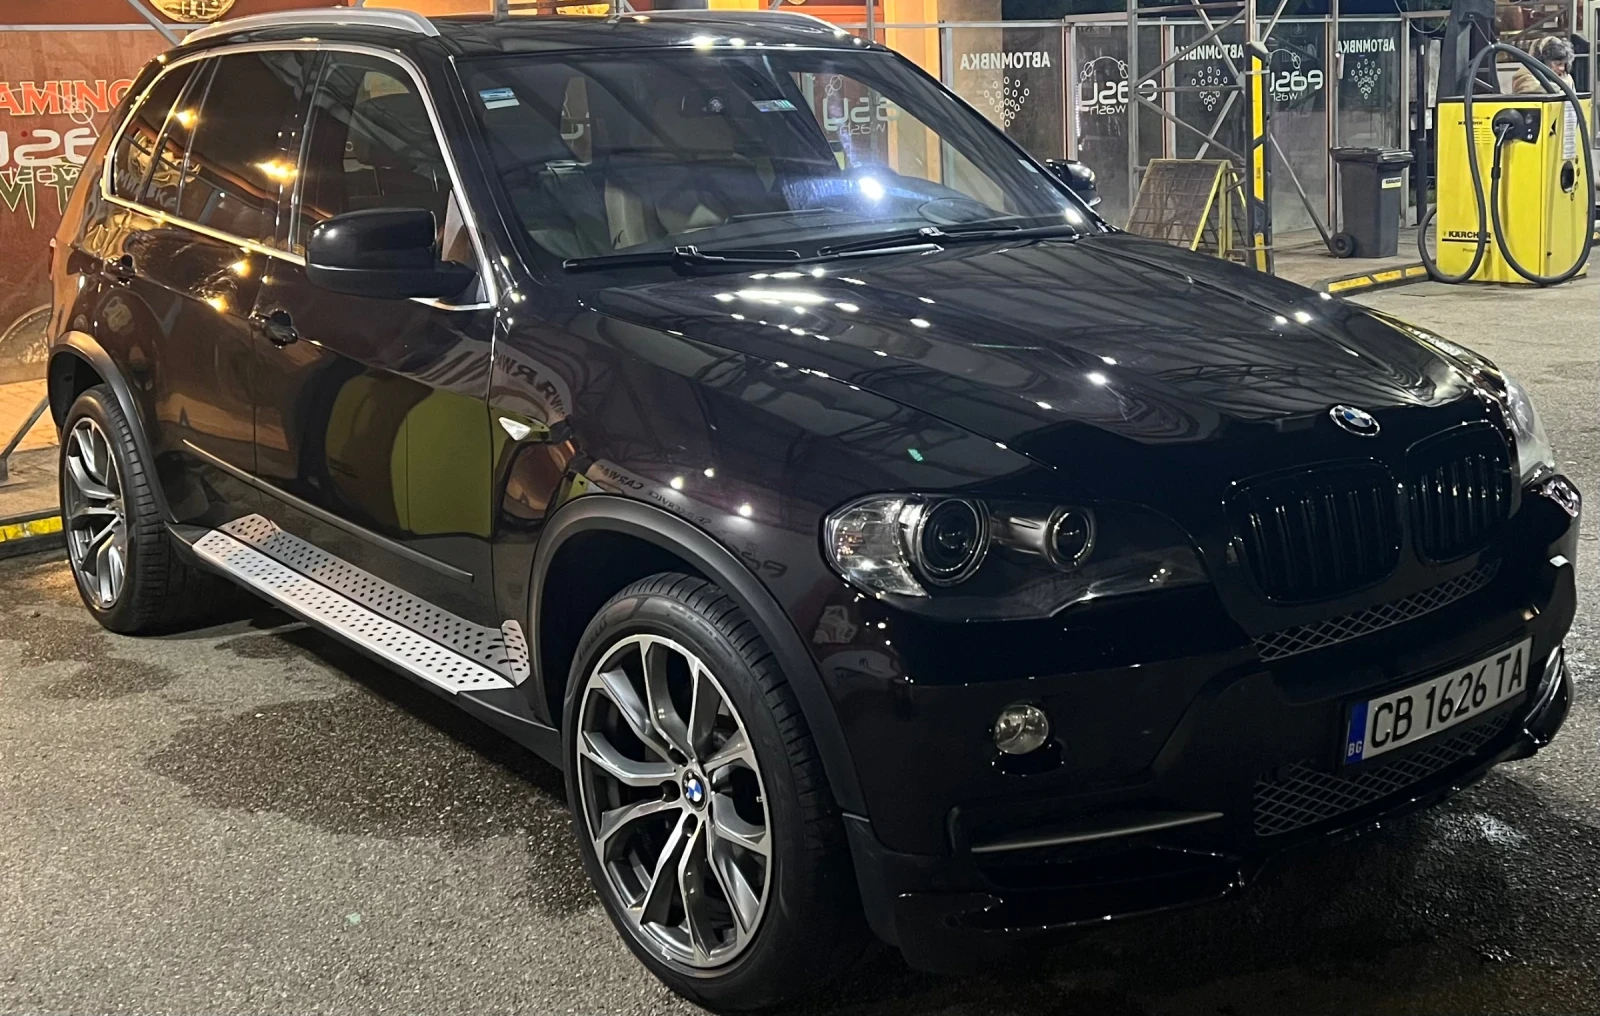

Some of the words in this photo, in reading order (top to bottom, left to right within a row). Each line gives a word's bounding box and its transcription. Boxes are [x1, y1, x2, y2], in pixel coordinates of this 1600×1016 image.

[1370, 695, 1414, 749] CB
[1425, 663, 1488, 730] 1626
[1496, 647, 1523, 698] TA
[1347, 741, 1364, 757] BG
